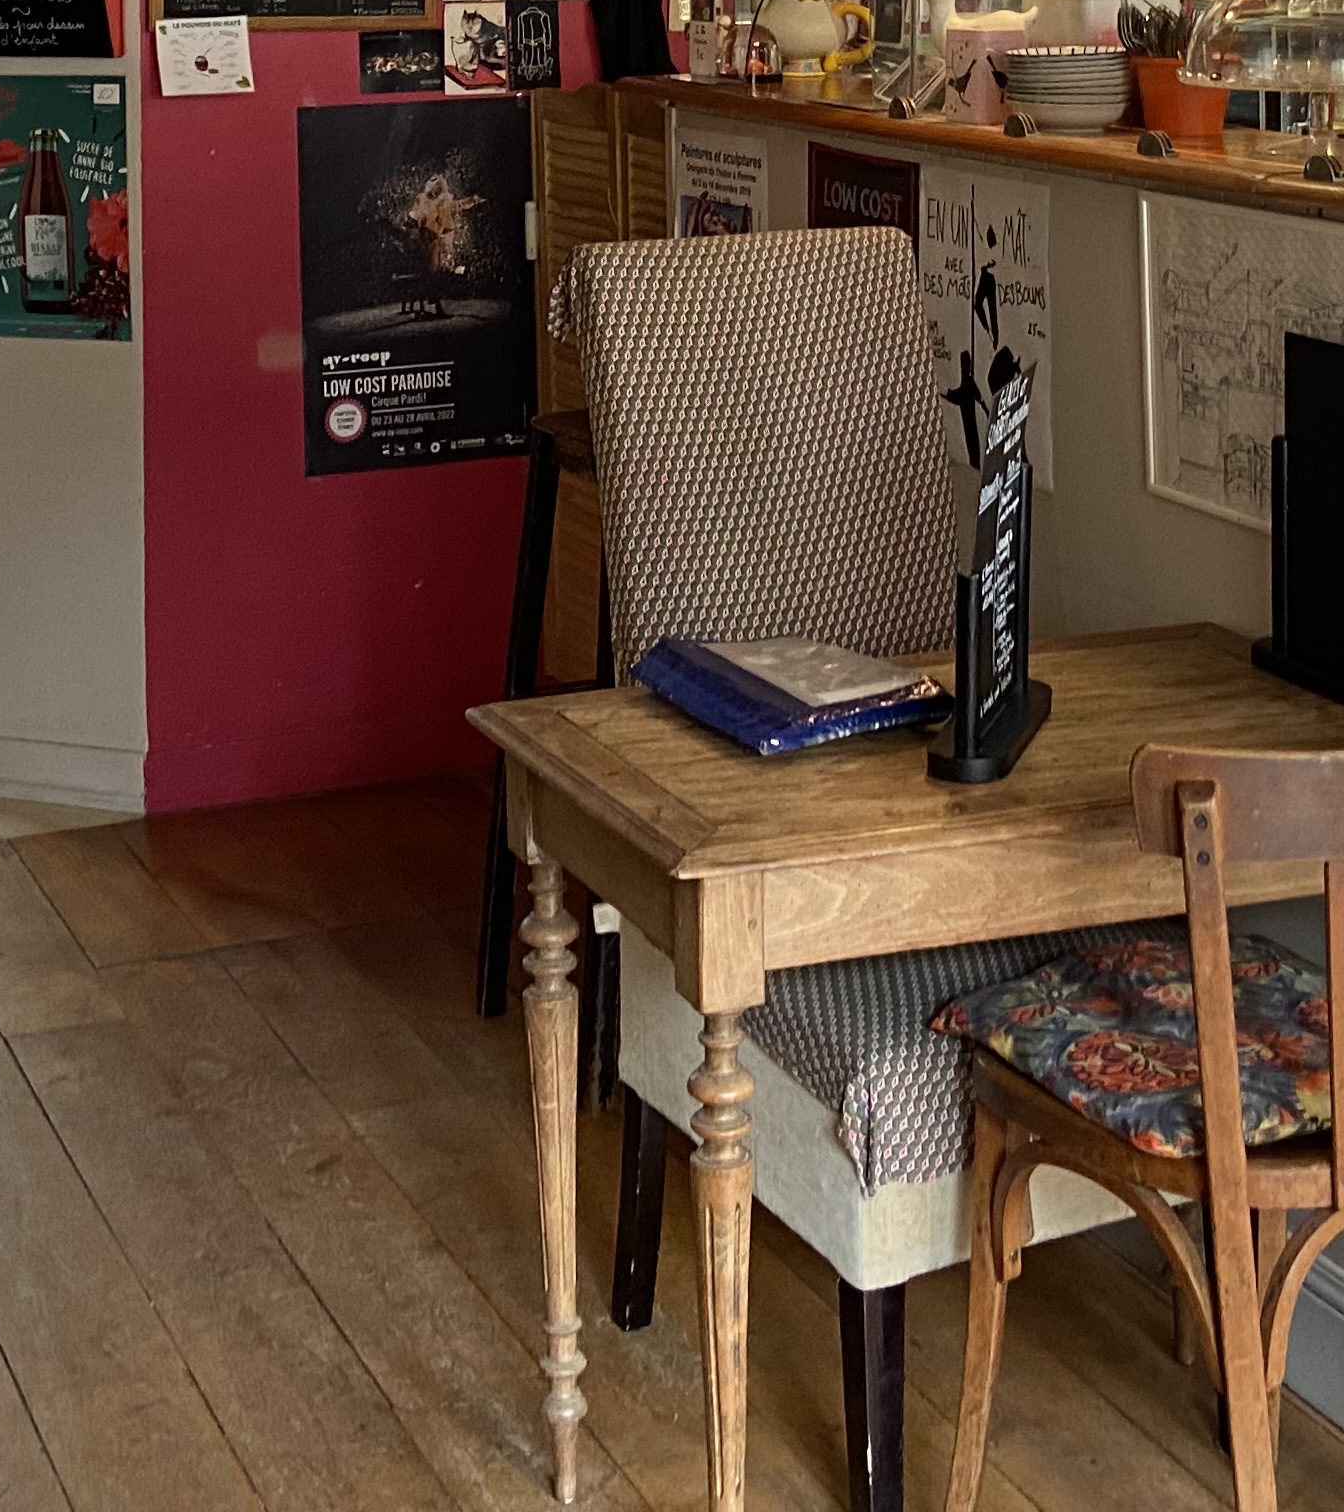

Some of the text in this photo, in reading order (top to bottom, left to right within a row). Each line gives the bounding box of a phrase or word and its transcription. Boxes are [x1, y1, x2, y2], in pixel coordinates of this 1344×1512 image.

[823, 178, 902, 225] LOW COST
[927, 198, 946, 243] EN
[323, 369, 451, 398] LOW COST PARADISE
